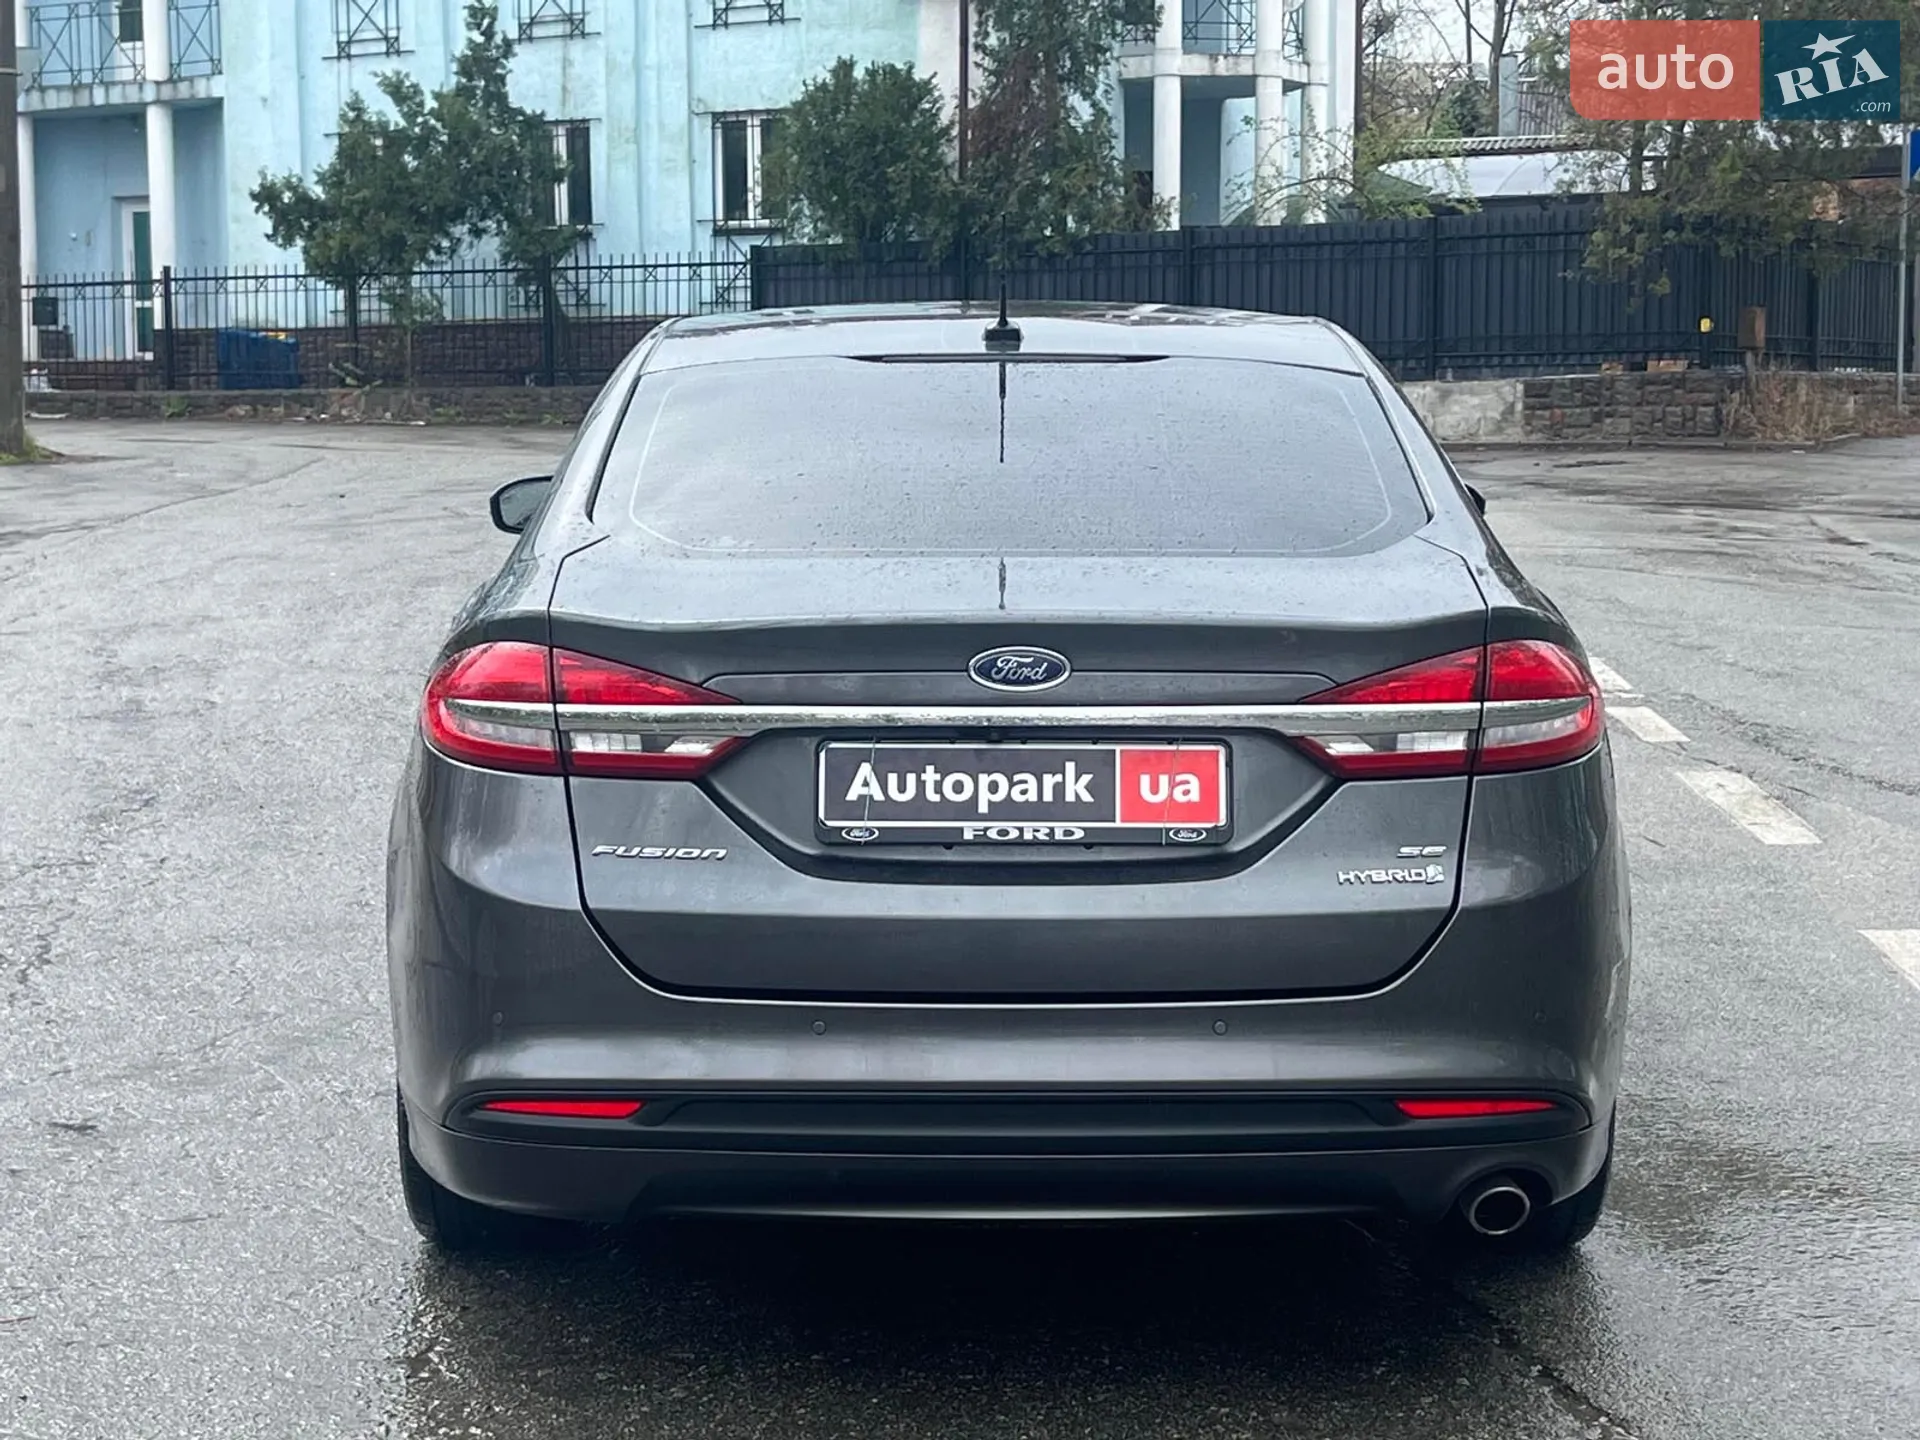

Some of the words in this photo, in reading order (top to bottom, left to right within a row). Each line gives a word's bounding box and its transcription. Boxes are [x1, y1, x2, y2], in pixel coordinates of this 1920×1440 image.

[991, 656, 1048, 680] Ford
[844, 762, 1095, 814] Autopark
[1138, 772, 1200, 804] ua
[962, 826, 1086, 841] FORD
[591, 845, 729, 860] FUSION
[1396, 845, 1448, 858] SE
[1337, 868, 1427, 883] HYBRID
